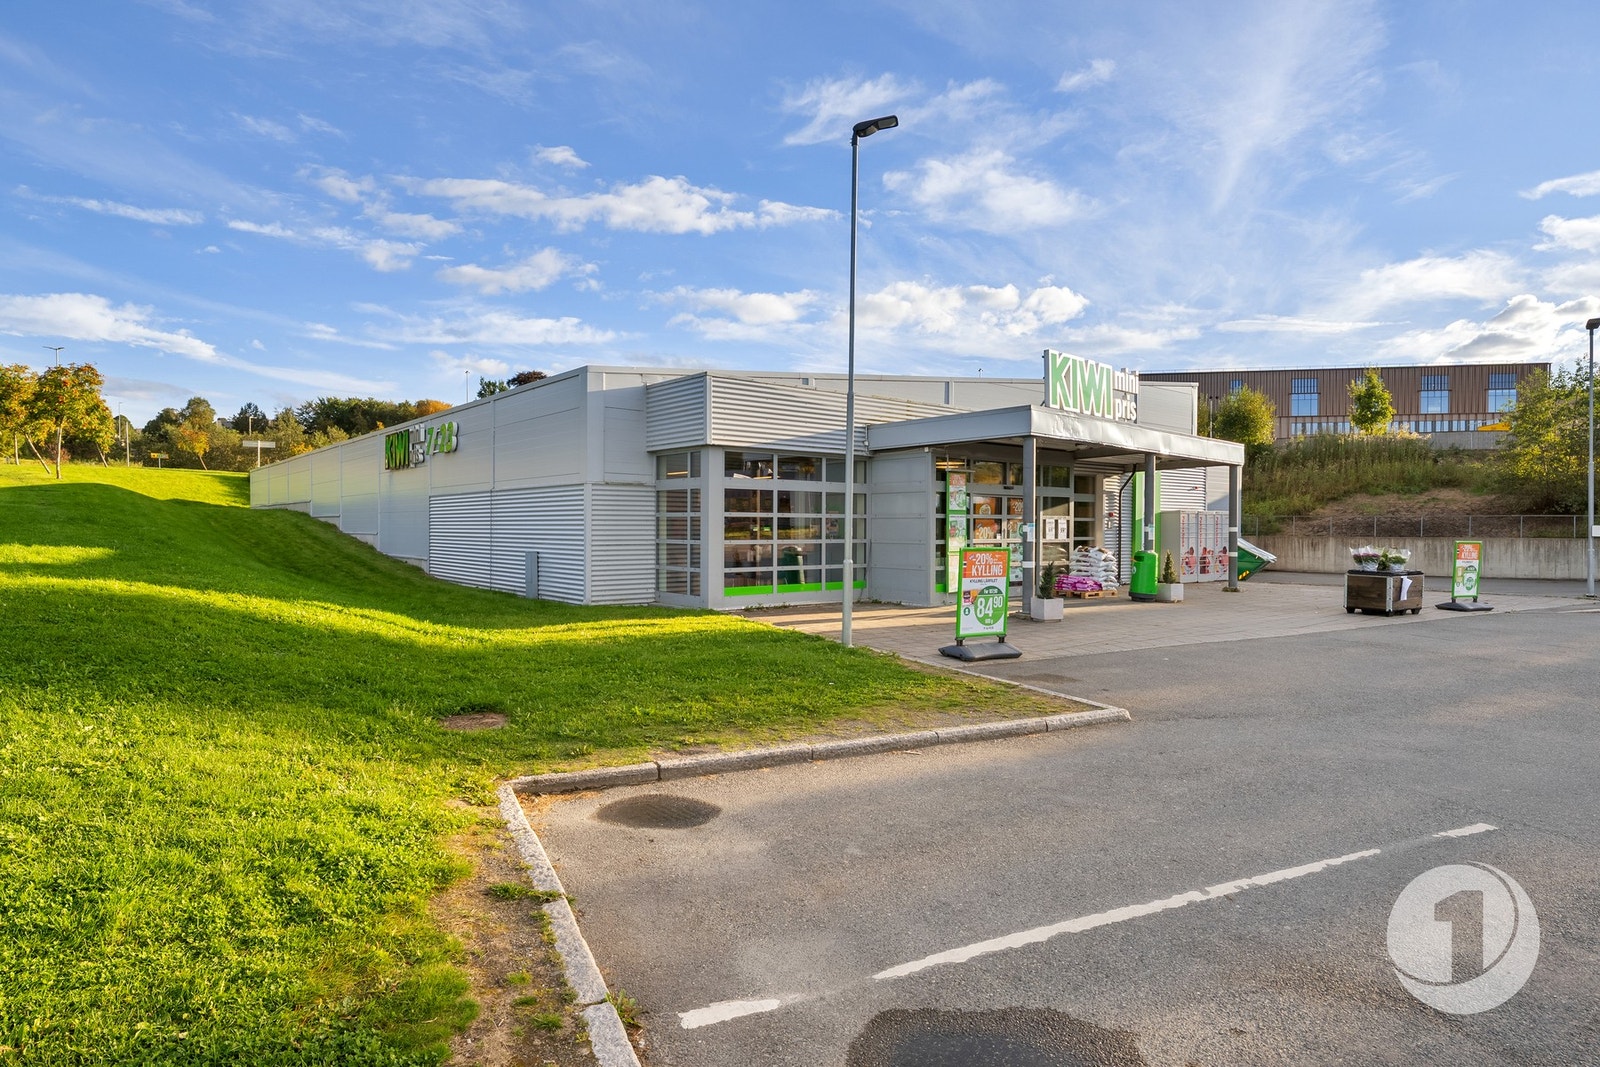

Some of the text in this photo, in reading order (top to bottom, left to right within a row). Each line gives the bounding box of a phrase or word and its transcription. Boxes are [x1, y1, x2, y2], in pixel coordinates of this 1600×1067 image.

[1048, 349, 1139, 419] KIWI mini
[1114, 394, 1138, 422] pris
[385, 428, 410, 470] KIWI
[971, 564, 1003, 577] KYLLING
